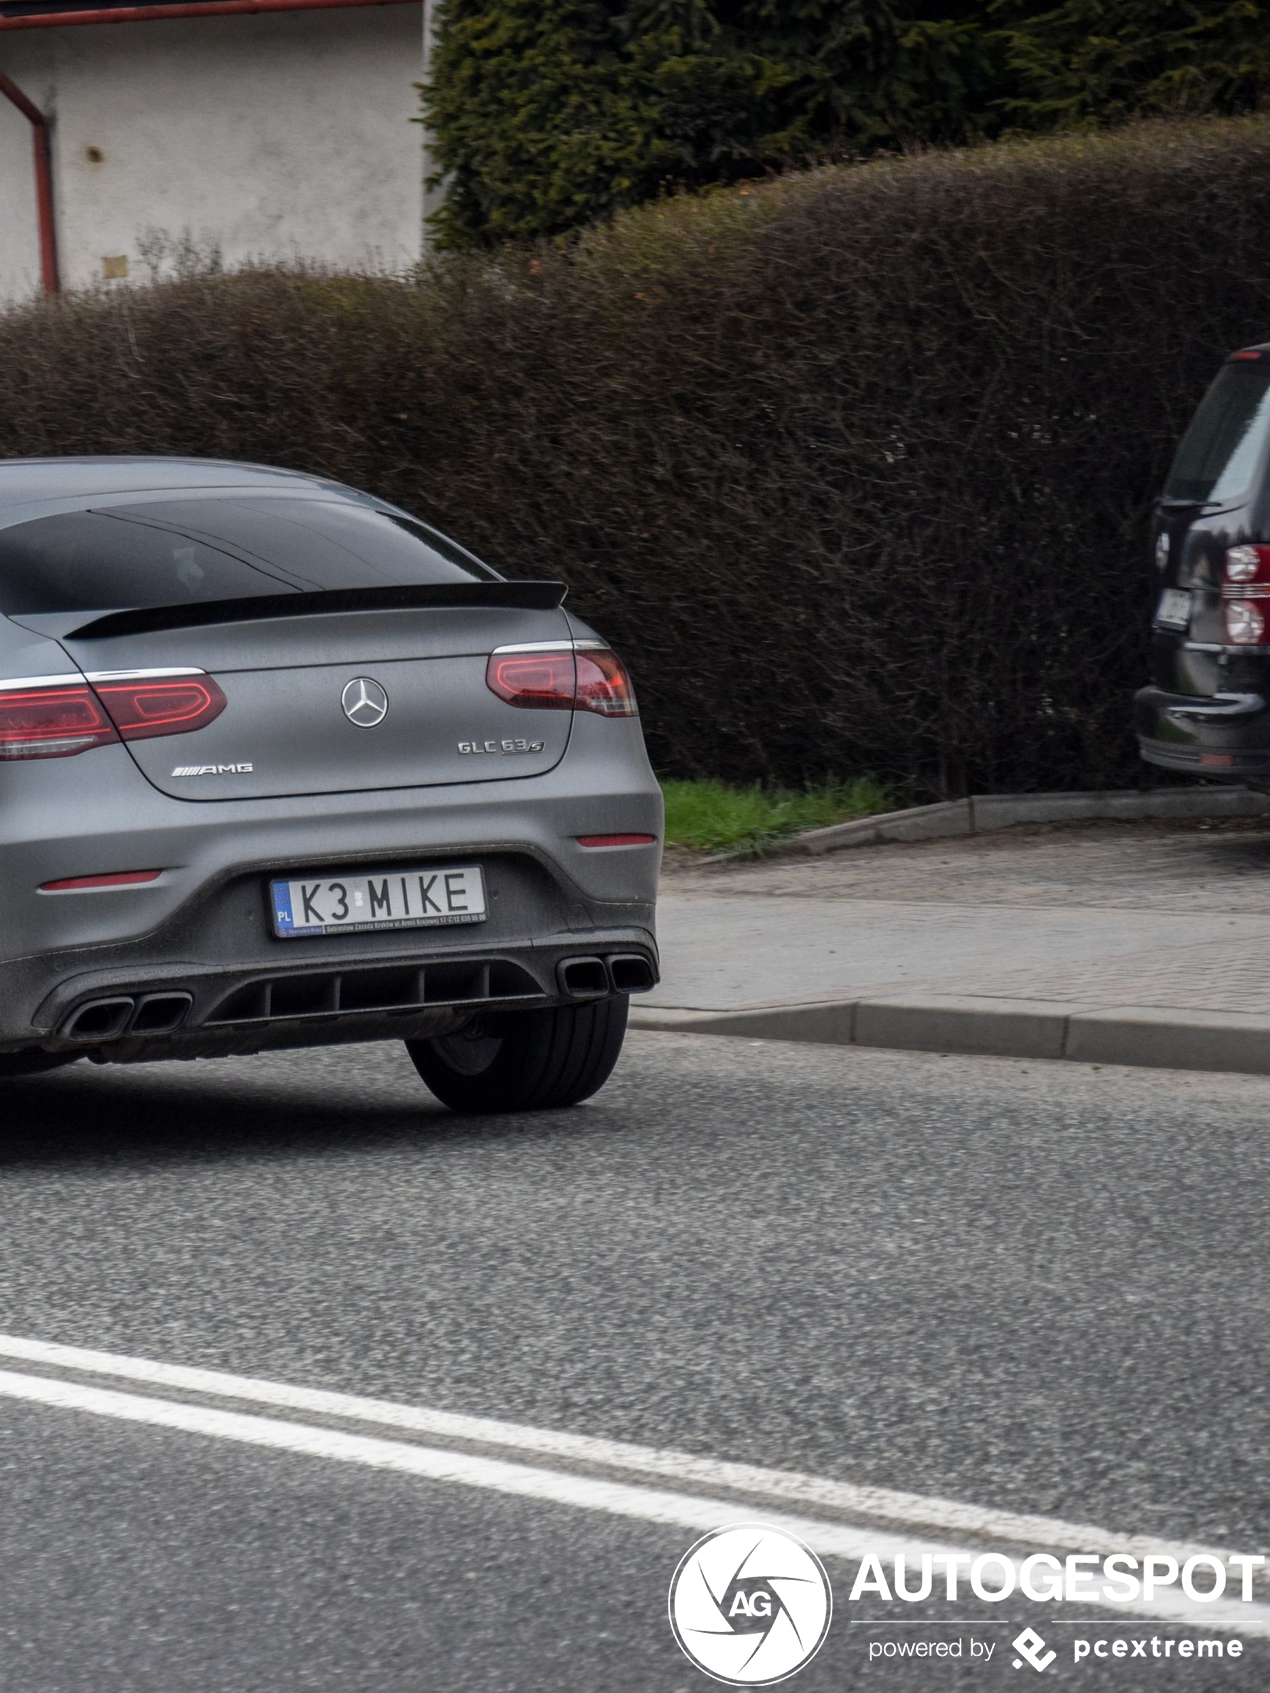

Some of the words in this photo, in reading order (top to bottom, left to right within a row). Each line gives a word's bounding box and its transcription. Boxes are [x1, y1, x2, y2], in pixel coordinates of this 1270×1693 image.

[458, 741, 497, 754] GLC
[277, 911, 291, 922] PL
[354, 922, 374, 930] Zasada
[374, 920, 394, 929] Kraków
